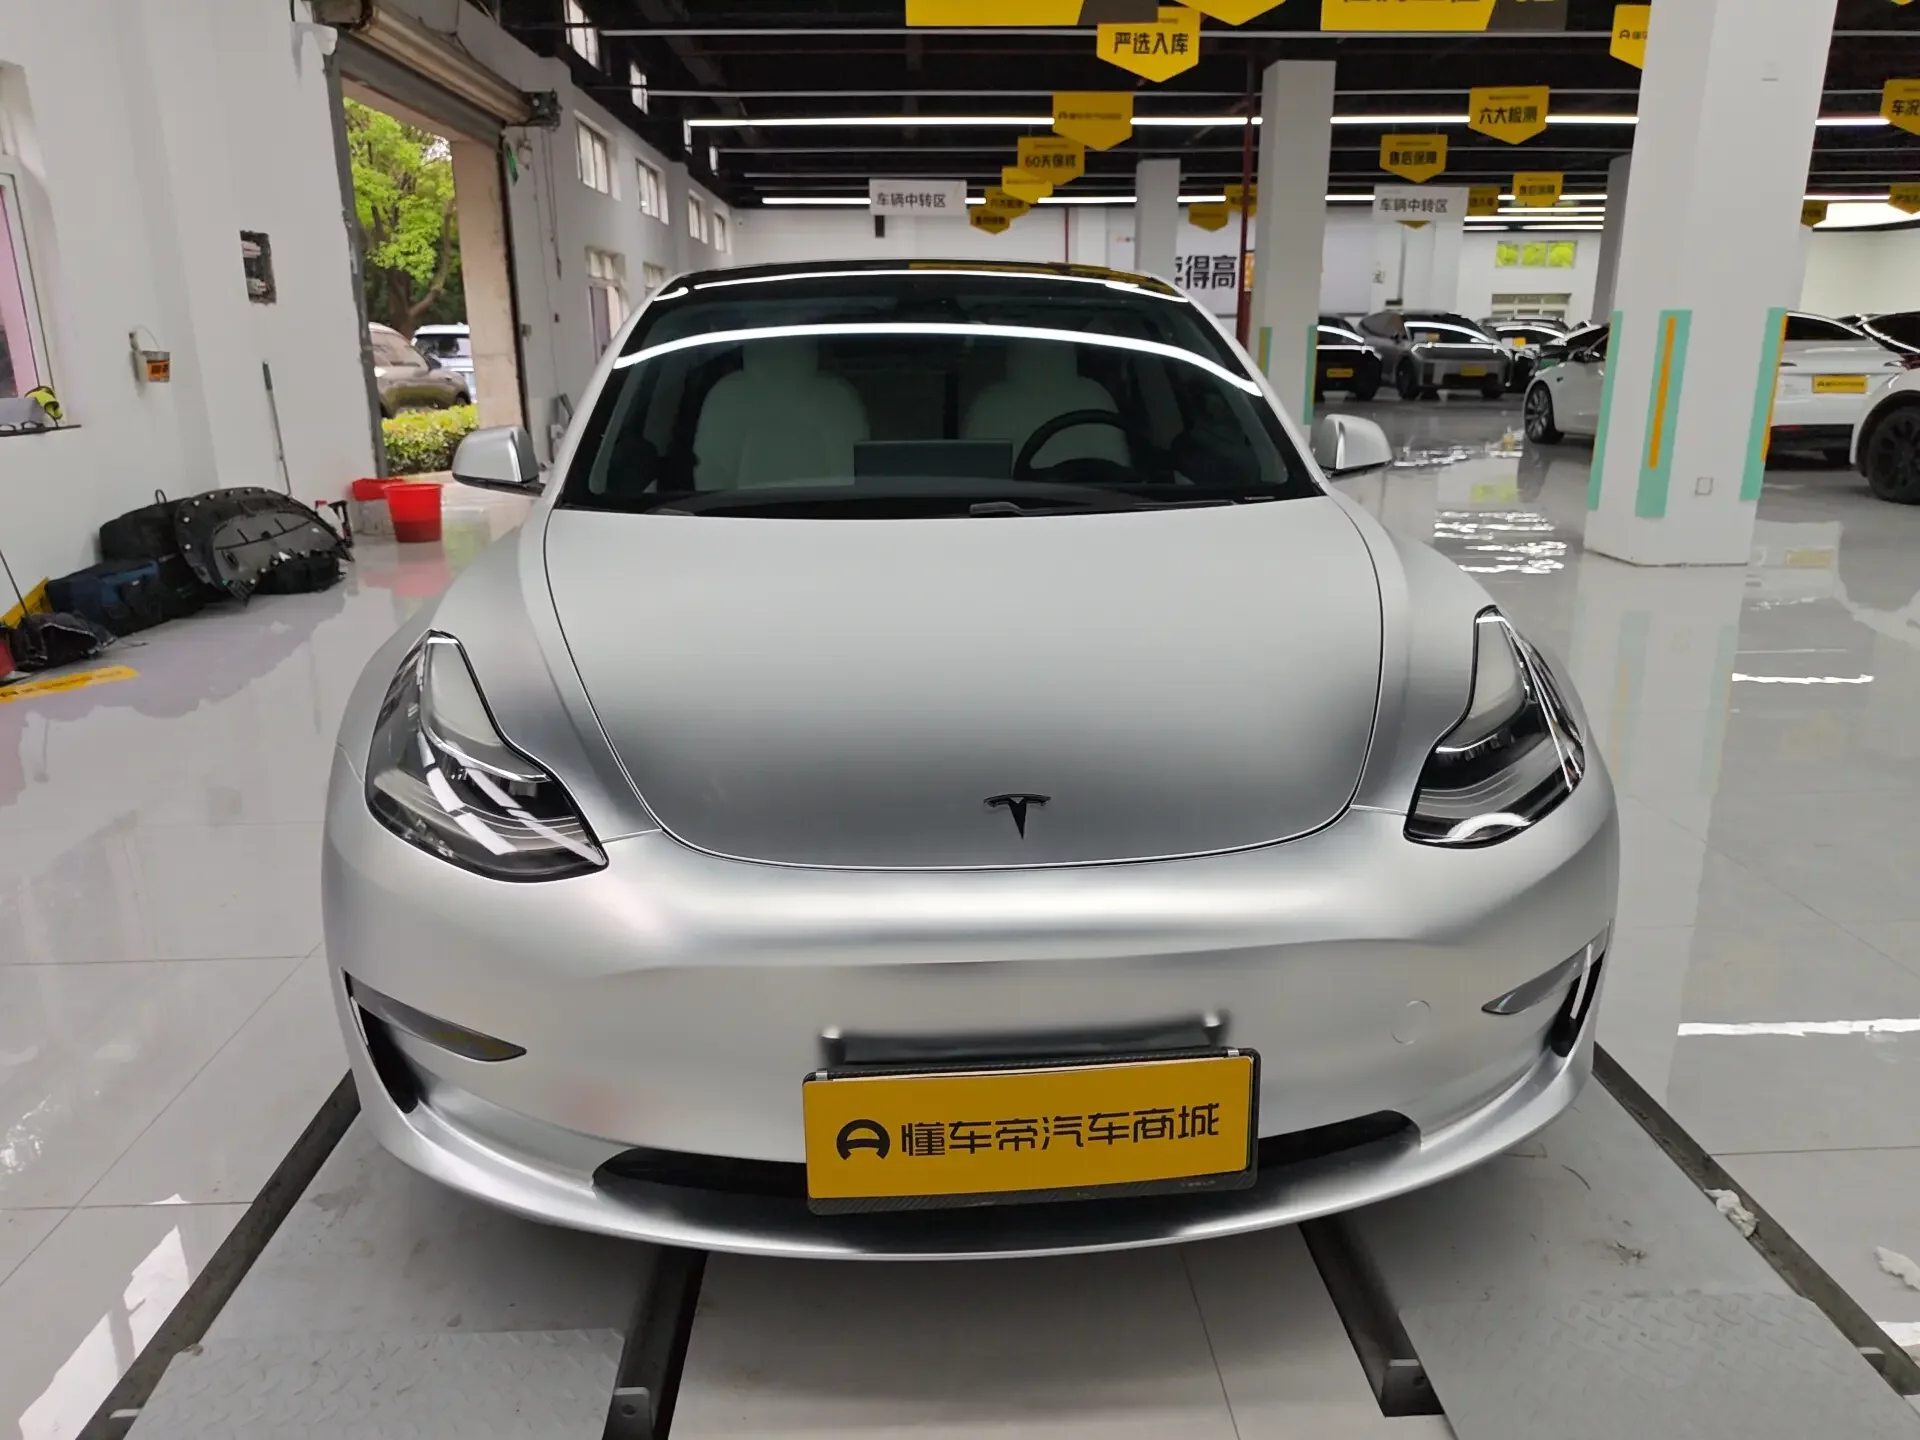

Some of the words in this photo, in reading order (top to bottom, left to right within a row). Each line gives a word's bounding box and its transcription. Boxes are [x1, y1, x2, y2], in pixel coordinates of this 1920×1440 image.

[1113, 31, 1189, 55] 严选入库
[1479, 105, 1538, 124] 六大检测
[876, 192, 947, 209] 车辆中转区
[1380, 197, 1449, 214] 车辆中转区
[901, 1103, 1220, 1157] 懂车帝汽车商城
